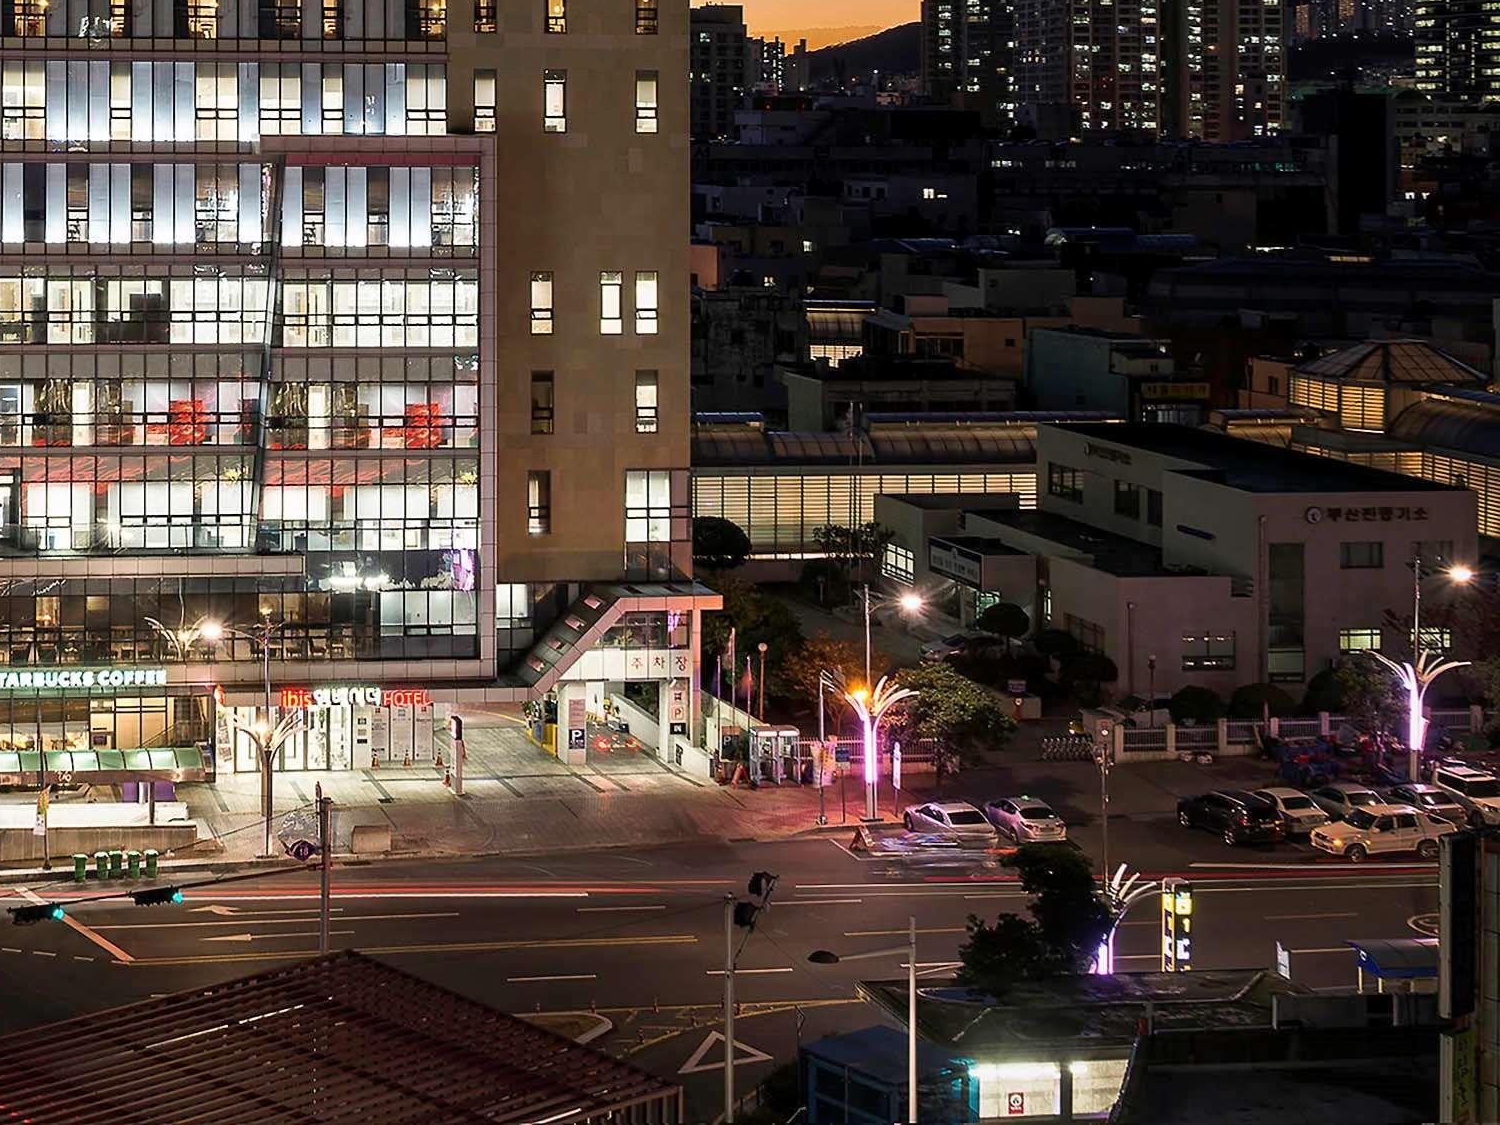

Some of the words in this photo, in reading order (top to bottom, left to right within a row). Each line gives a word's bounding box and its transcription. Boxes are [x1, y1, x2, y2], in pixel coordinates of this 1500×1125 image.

[631, 656, 687, 671] 주차장
[97, 670, 167, 687] COFFEE
[282, 690, 312, 708] ibis
[383, 690, 433, 707] HOTEL
[571, 730, 583, 744] P
